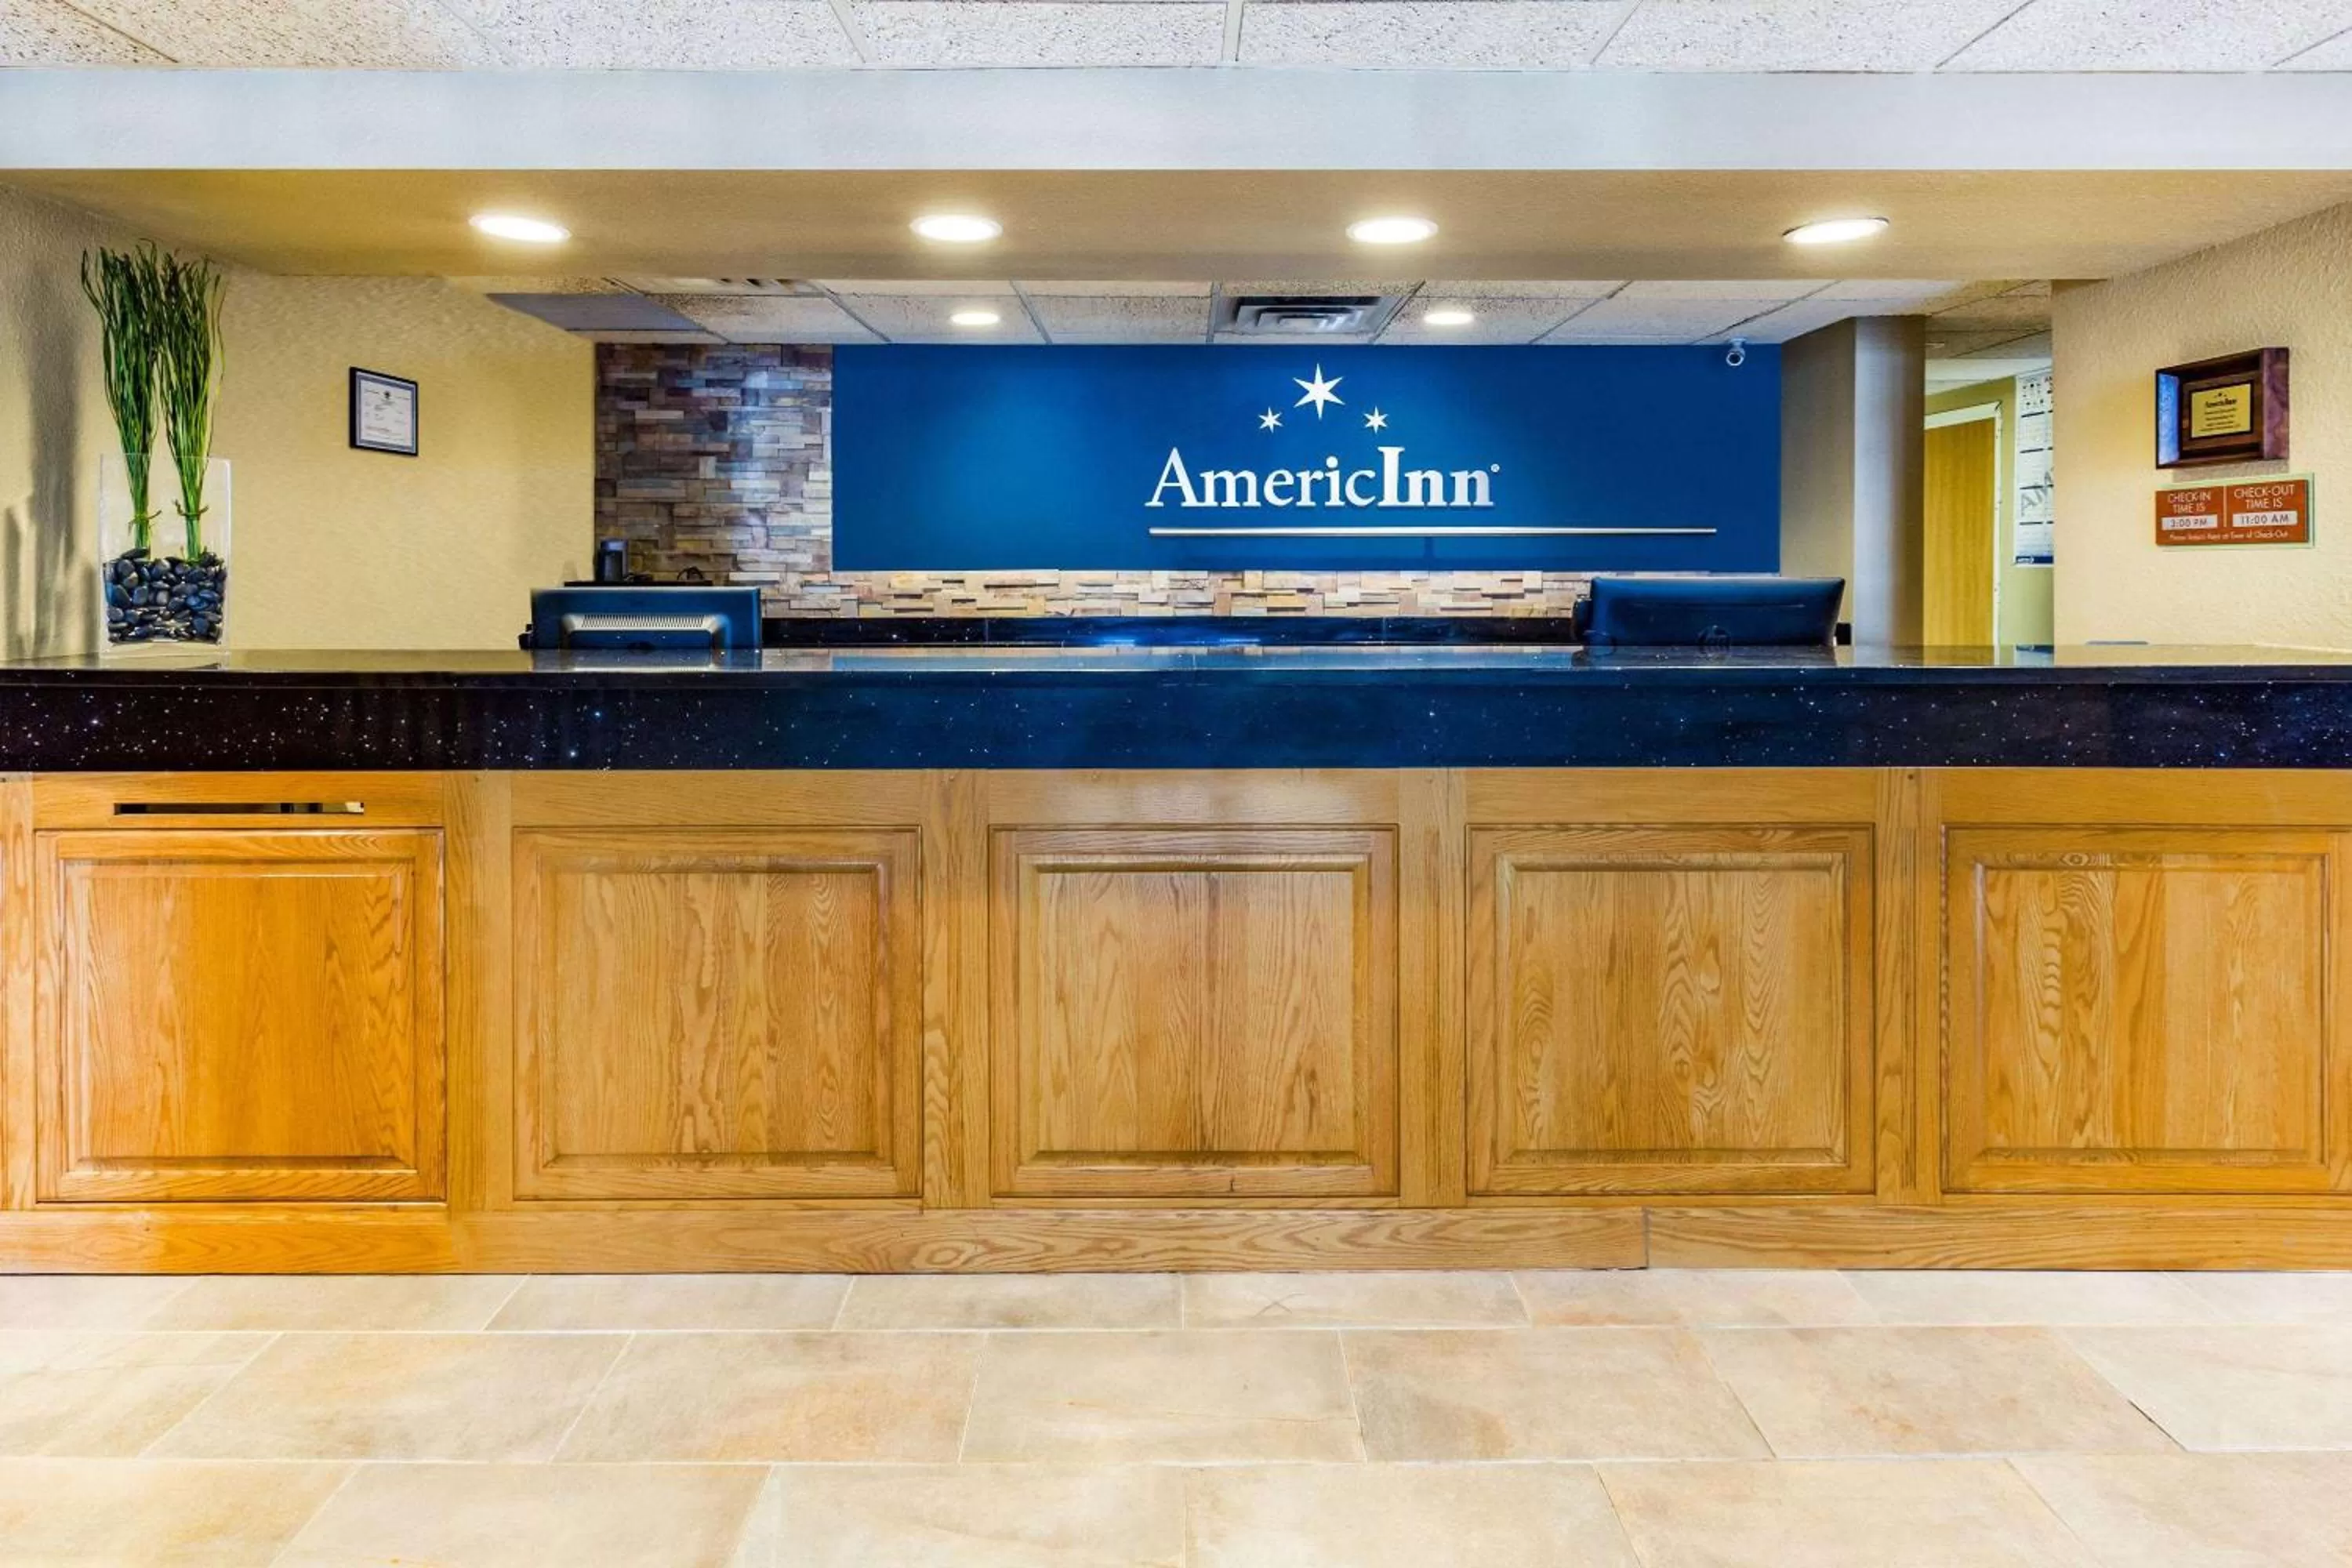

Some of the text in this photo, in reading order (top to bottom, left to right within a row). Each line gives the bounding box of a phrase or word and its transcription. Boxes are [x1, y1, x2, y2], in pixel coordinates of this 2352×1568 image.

[1145, 446, 1495, 506] AmericInn
[2168, 491, 2211, 503] CHECK-IN
[2234, 485, 2295, 499] CHECK-OUT
[2172, 502, 2206, 513] TIME IS
[2245, 497, 2283, 509] TIME IS
[2170, 518, 2190, 528] 3:00
[2241, 514, 2289, 524] 11:00 AM
[2255, 530, 2288, 539] Check-Out
